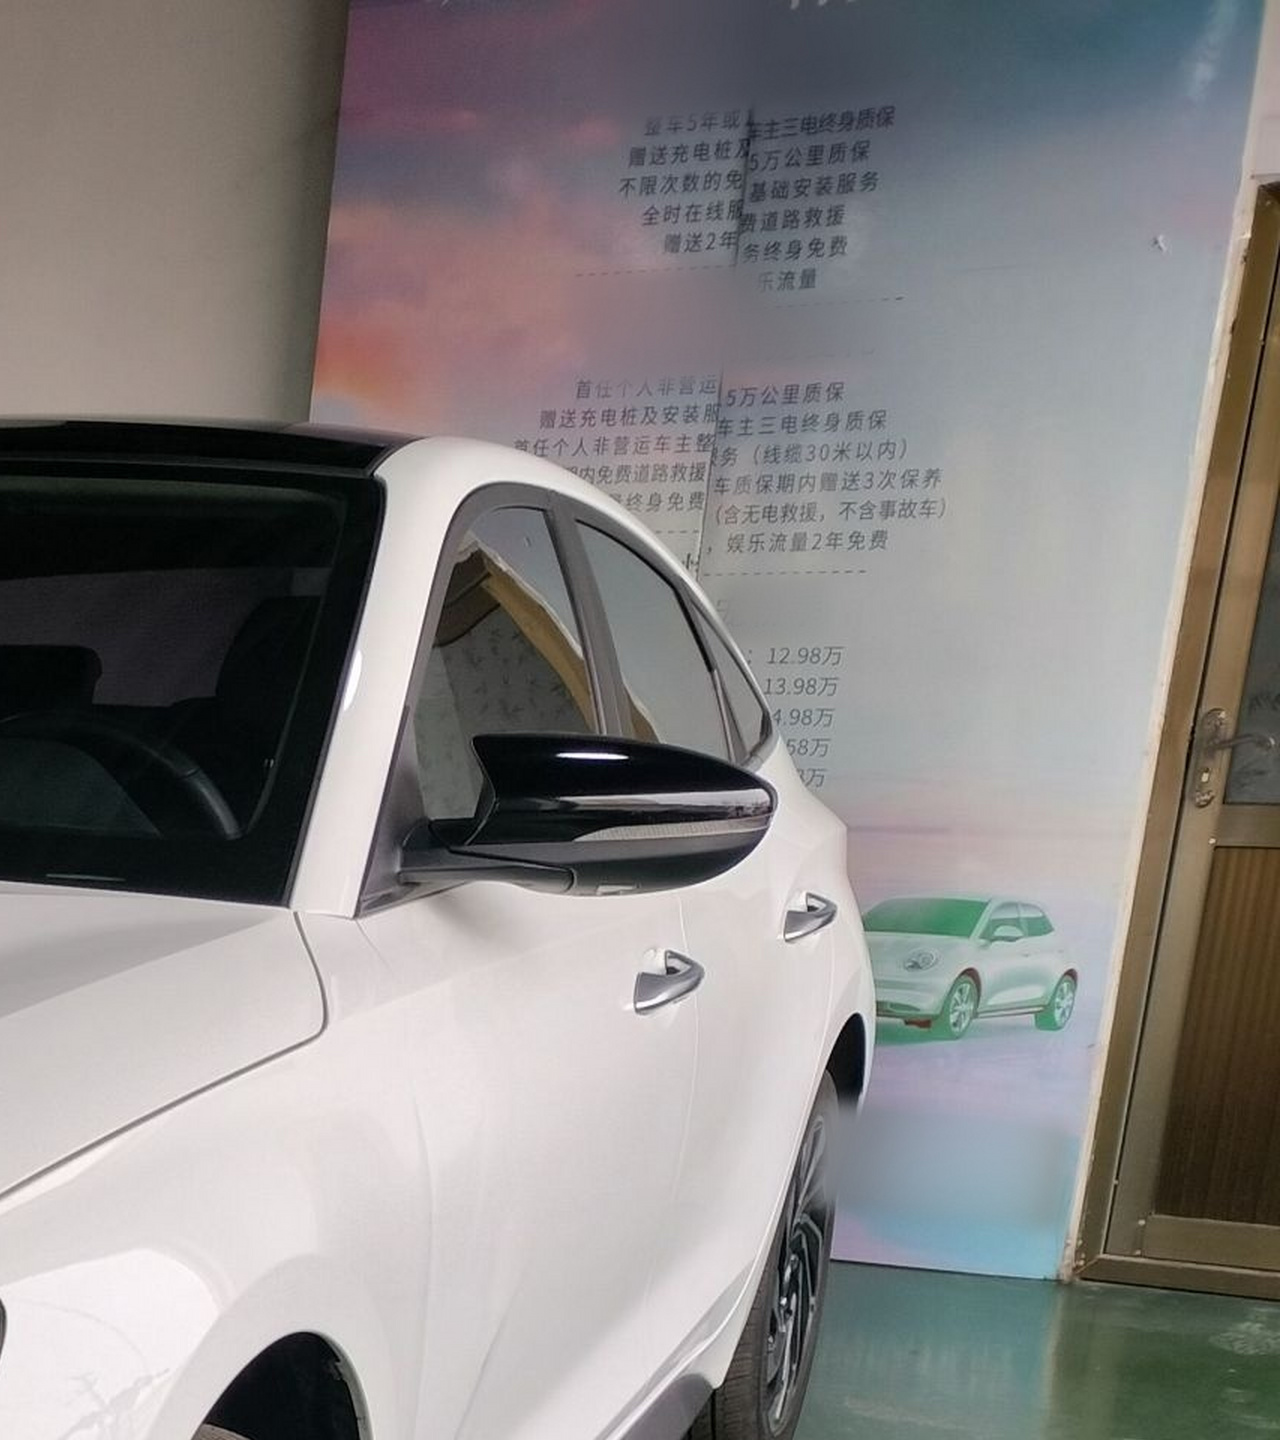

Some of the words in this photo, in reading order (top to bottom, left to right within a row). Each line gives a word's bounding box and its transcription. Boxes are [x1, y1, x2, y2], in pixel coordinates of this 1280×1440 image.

[628, 138, 751, 168] 赠送充电桩及
[748, 171, 880, 204] 基础安装服务
[717, 409, 888, 437] 车主三电终身质保
[714, 467, 943, 496] 车质保期内赠送3次保养
